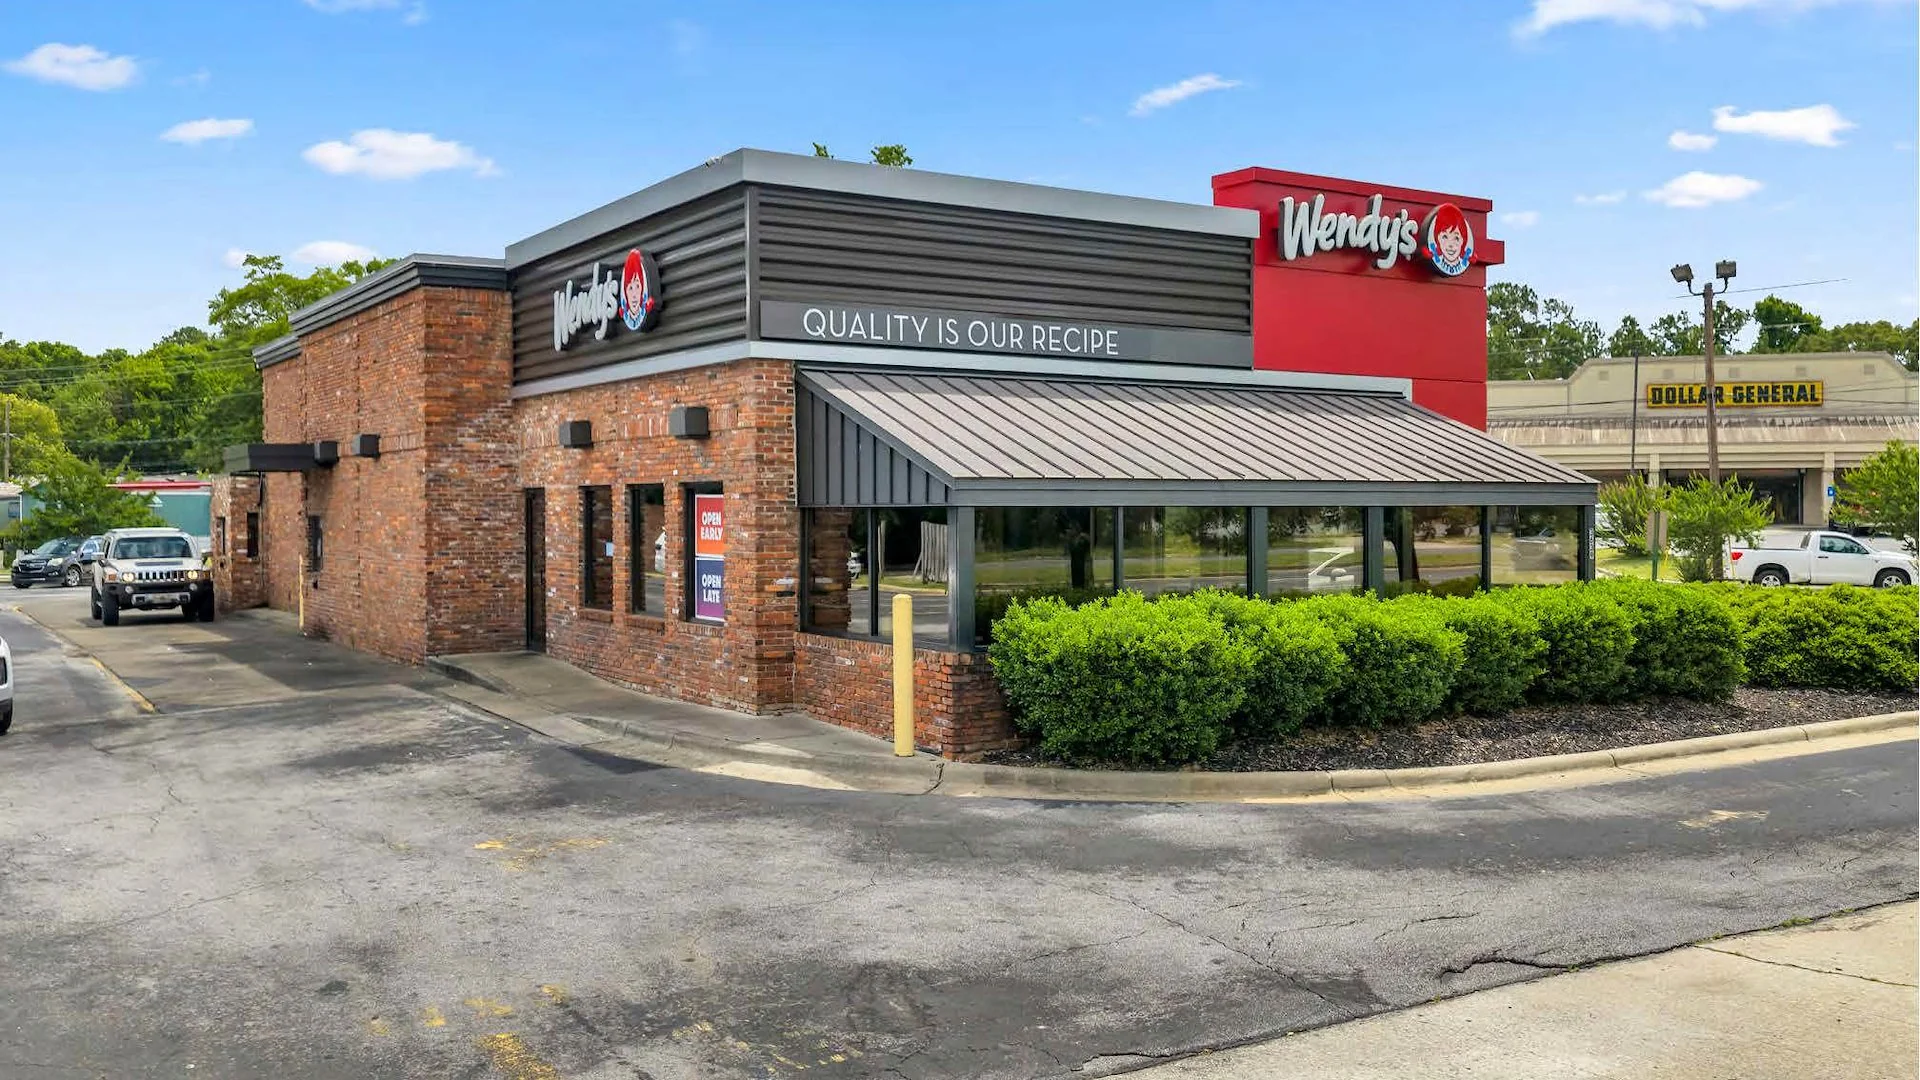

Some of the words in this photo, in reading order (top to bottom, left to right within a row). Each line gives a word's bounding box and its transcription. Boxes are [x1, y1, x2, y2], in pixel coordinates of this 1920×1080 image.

[1280, 193, 1418, 269] Wendy's
[553, 262, 618, 351] Wendy's
[802, 308, 929, 344] QUALITY
[937, 318, 960, 345] IS
[967, 320, 1024, 350] OUR
[1032, 325, 1120, 355] RECIPE
[1652, 386, 1724, 404] DOLLAR
[1732, 384, 1819, 404] GENERAL
[702, 511, 721, 525] OPEN
[700, 526, 723, 540] EARLY
[702, 574, 721, 588] OPEN
[703, 588, 721, 603] LATE
